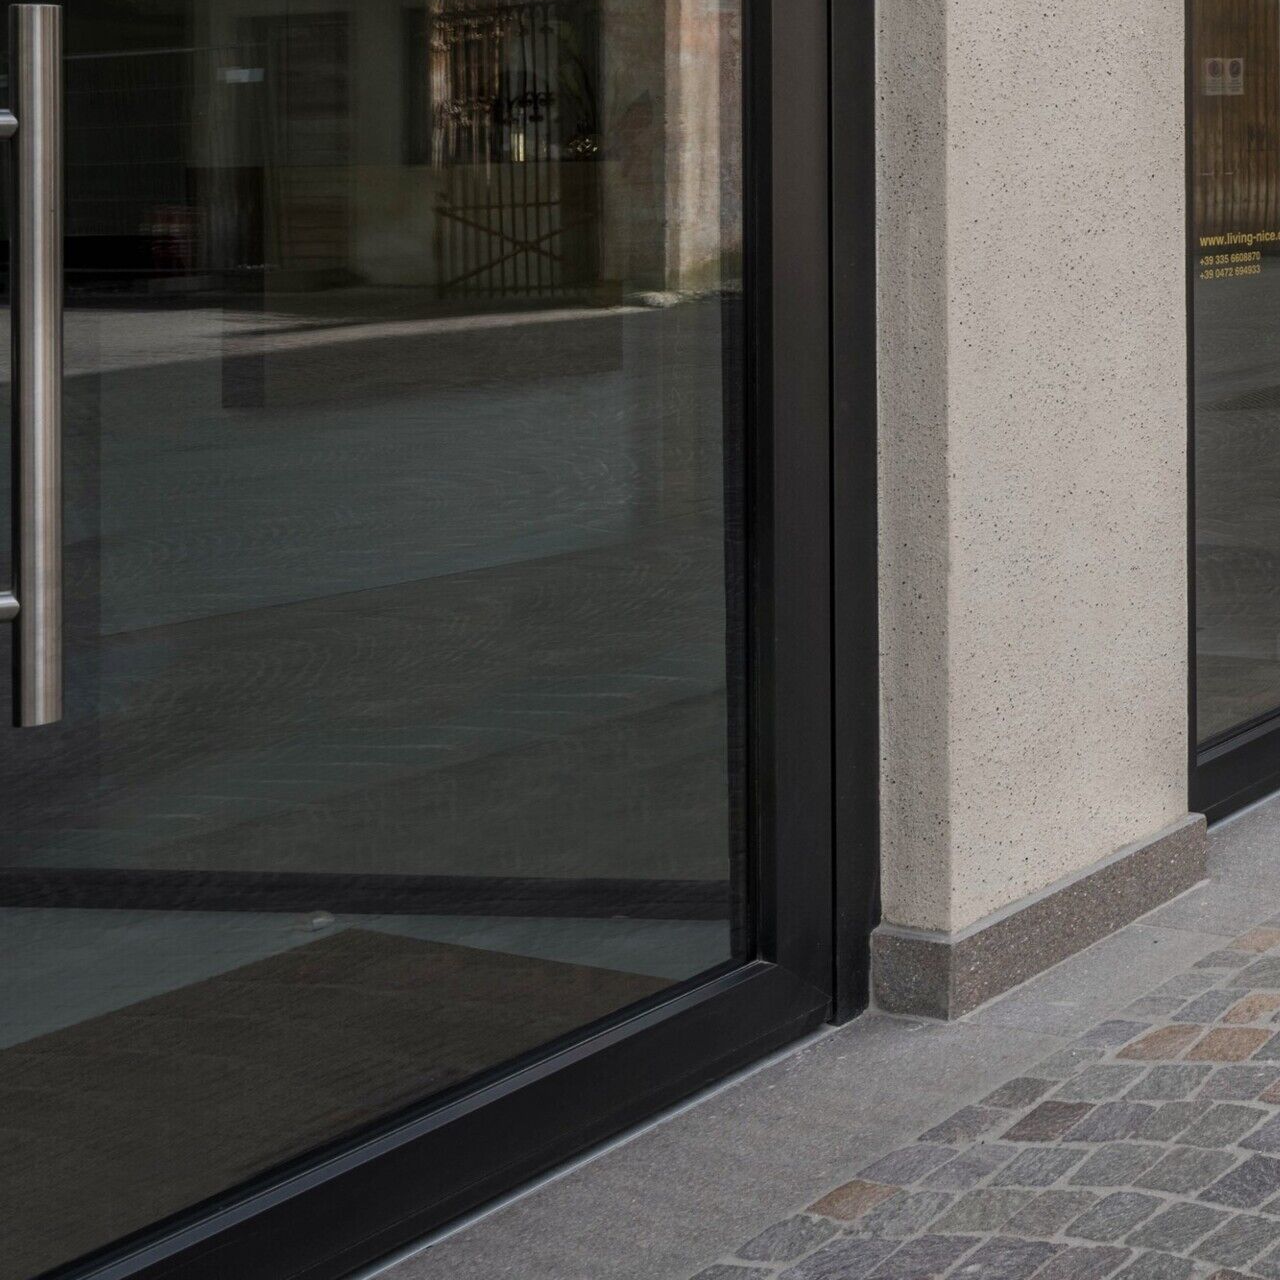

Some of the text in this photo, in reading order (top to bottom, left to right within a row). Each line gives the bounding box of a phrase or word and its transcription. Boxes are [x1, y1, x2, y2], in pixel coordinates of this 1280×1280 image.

[1200, 256, 1213, 266] +39
[1200, 269, 1213, 280] +39
[1215, 267, 1233, 278] 0472
